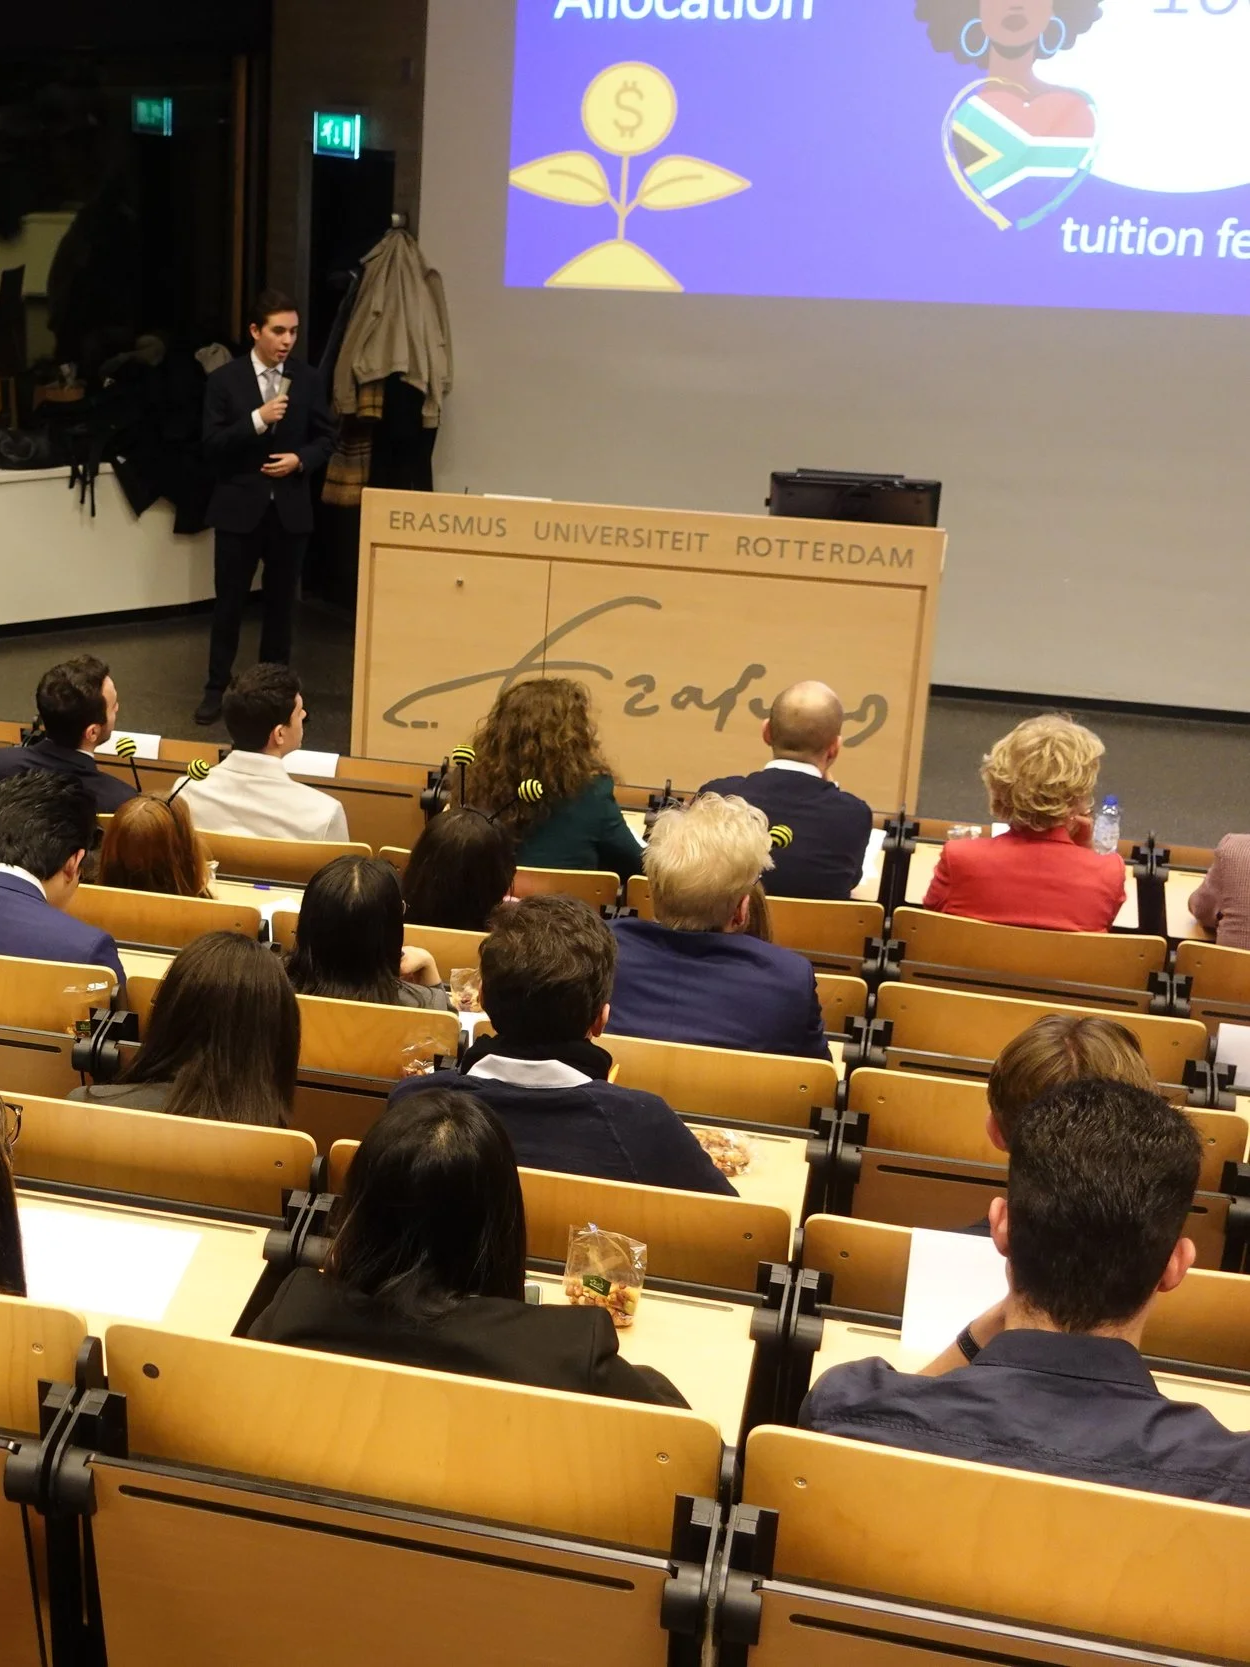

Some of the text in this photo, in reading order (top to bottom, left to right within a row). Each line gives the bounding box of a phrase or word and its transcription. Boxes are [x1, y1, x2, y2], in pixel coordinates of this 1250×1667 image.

[1060, 215, 1205, 257] tuition
[388, 509, 916, 570] ERASMUS UNIVERSITEIT ROTTERDAM
